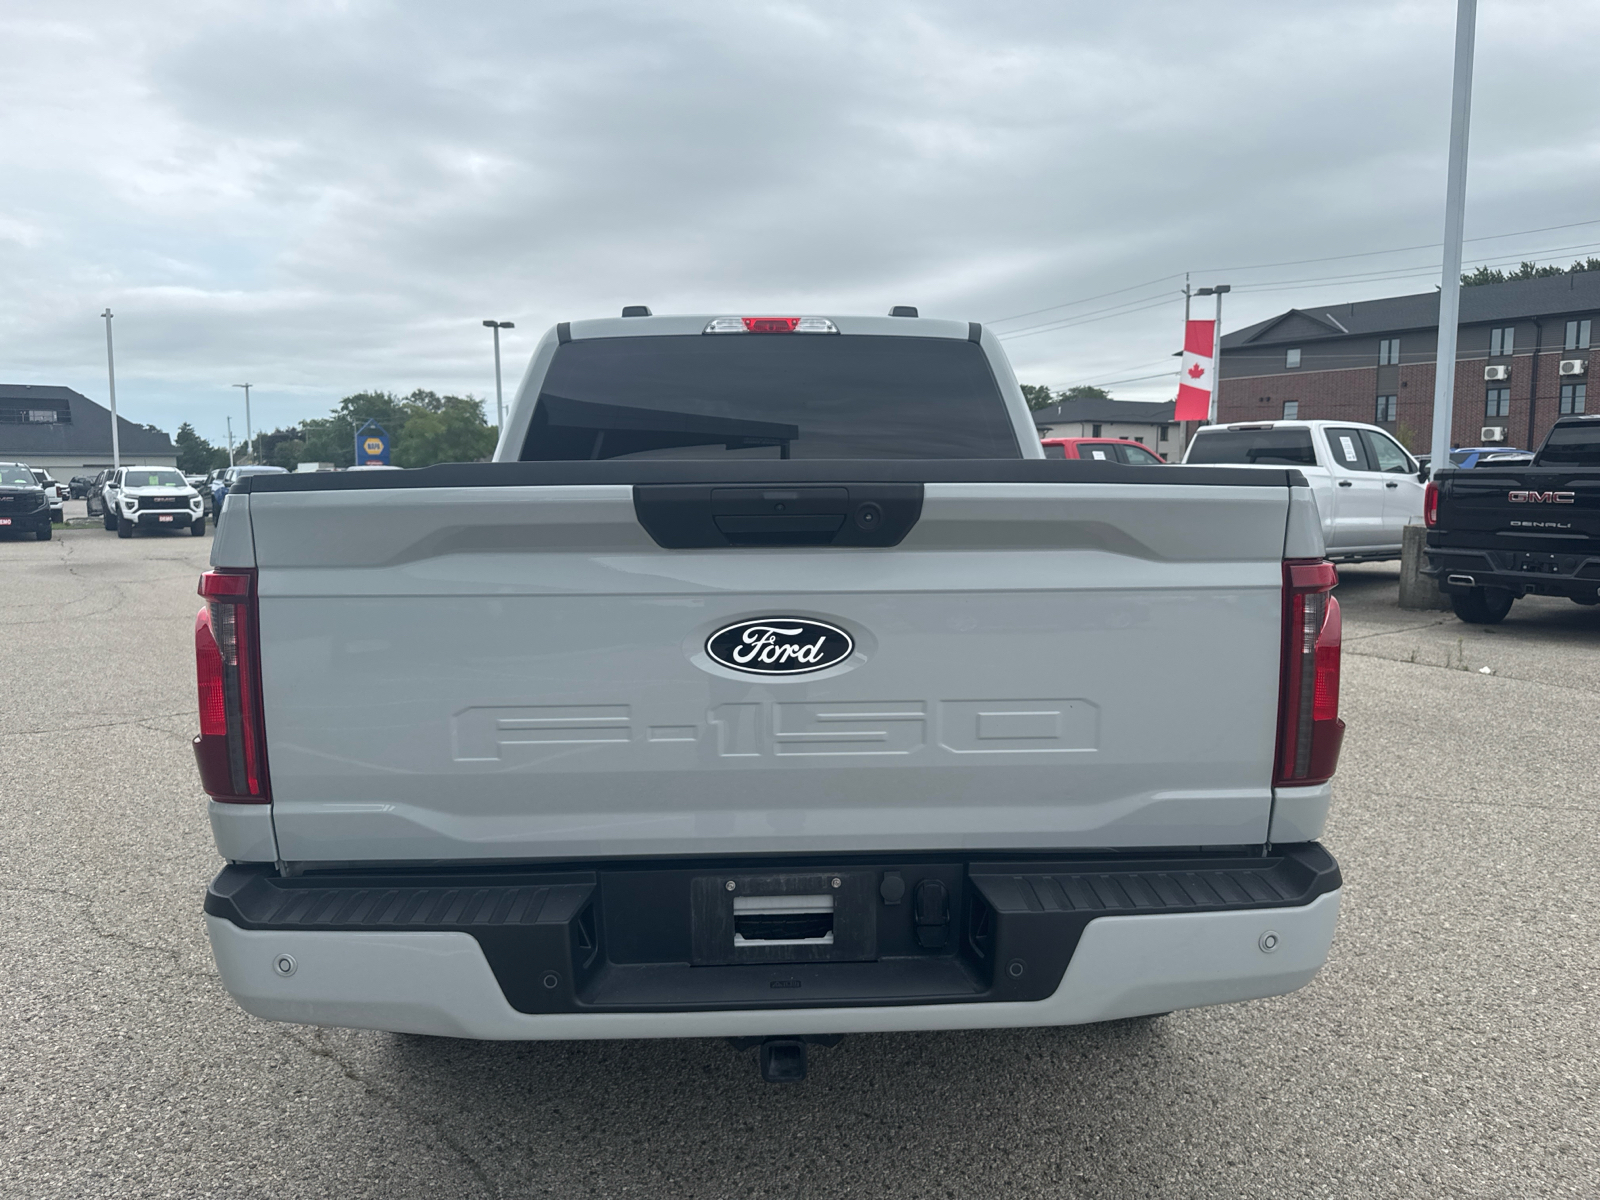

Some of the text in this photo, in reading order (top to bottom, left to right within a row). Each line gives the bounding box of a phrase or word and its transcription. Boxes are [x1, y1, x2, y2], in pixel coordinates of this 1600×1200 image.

[1508, 491, 1575, 504] GMC
[733, 626, 826, 664] Ford
[452, 698, 1100, 761] F-150
